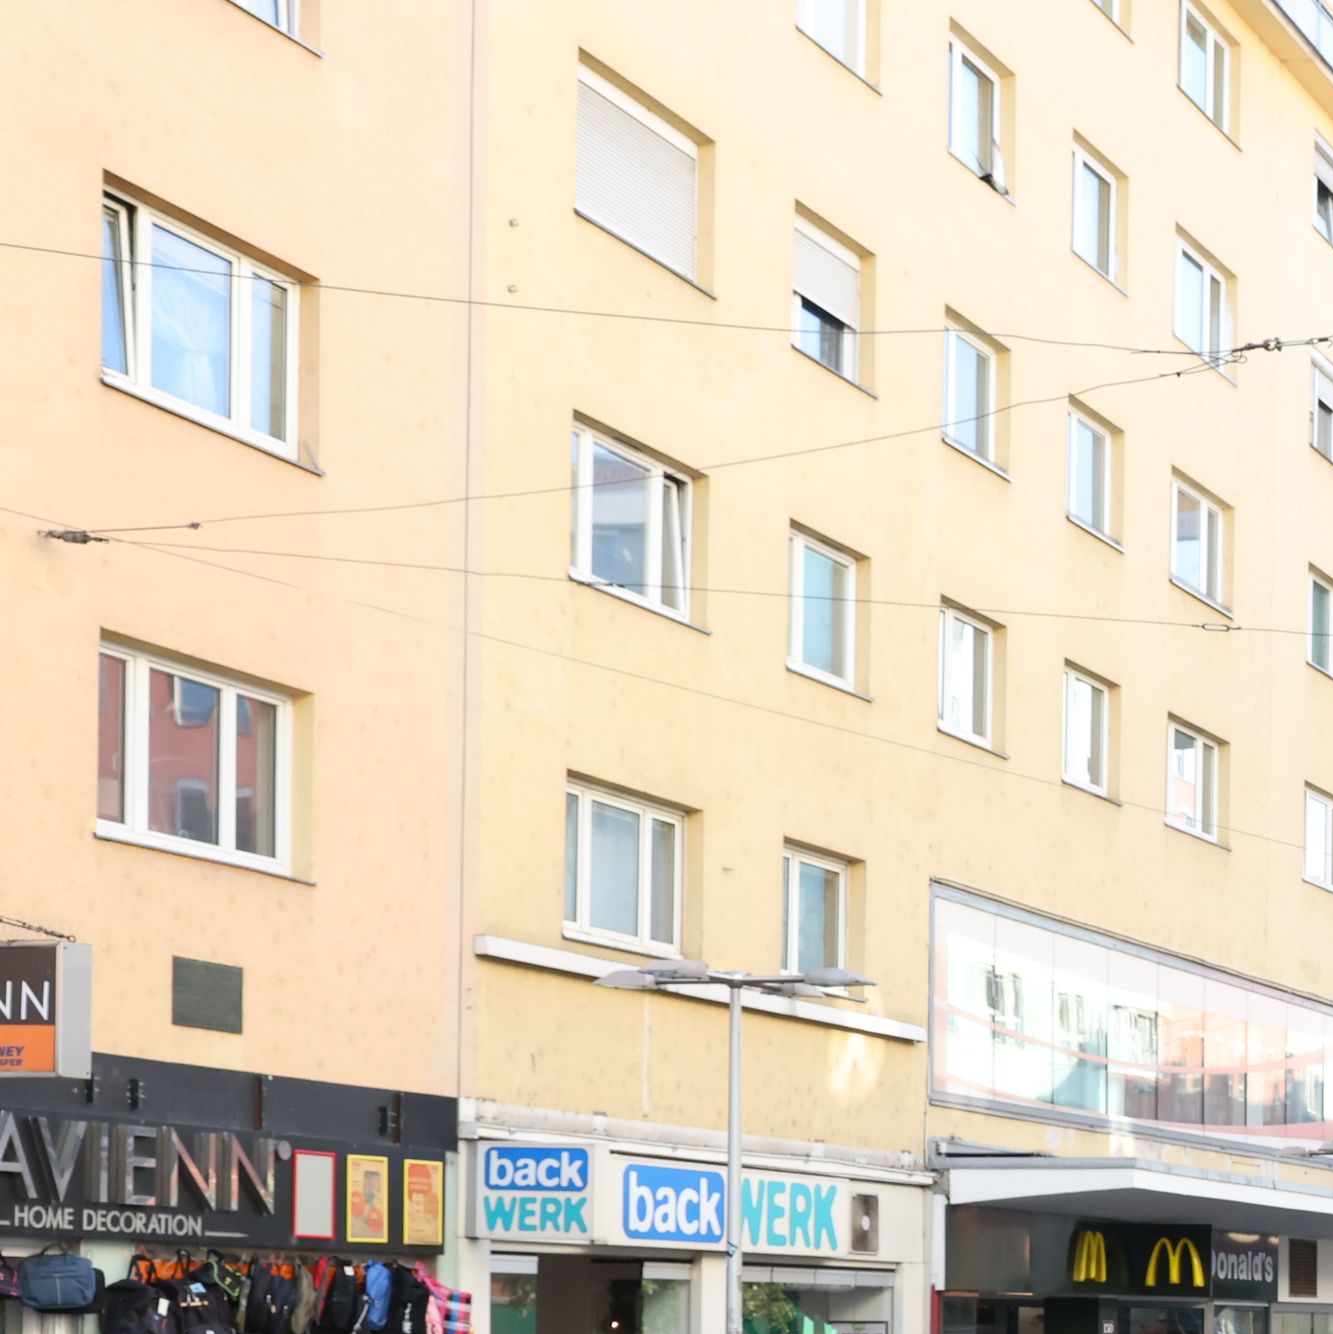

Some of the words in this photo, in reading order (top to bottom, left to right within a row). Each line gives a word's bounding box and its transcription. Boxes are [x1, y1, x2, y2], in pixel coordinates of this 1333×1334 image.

[489, 1150, 583, 1187] back
[14, 1205, 75, 1230] HOME
[82, 1208, 203, 1236] DECORATION
[483, 1196, 588, 1233] WERK
[628, 1171, 722, 1236] back
[1211, 1249, 1273, 1283] onald's
